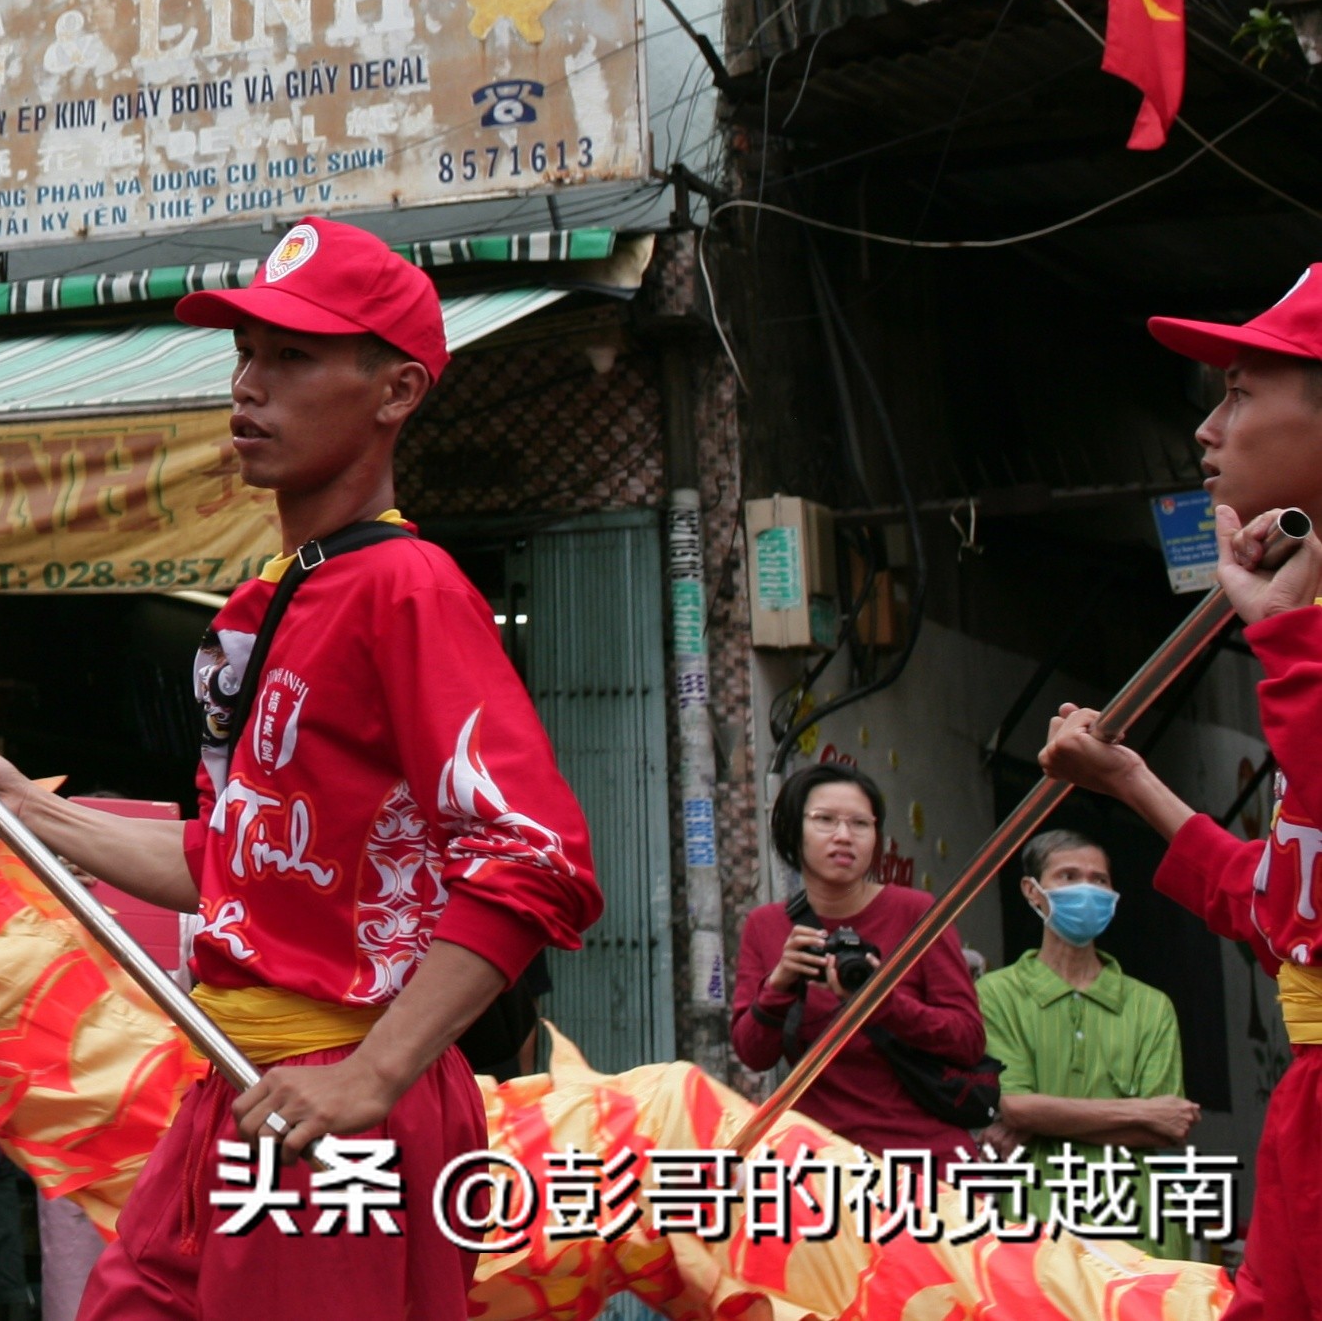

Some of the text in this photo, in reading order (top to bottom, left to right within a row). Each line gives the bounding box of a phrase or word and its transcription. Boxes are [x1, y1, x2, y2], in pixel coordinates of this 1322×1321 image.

[17, 96, 47, 133] ÉP
[243, 68, 275, 105] VÀ
[349, 55, 429, 92] DECAL
